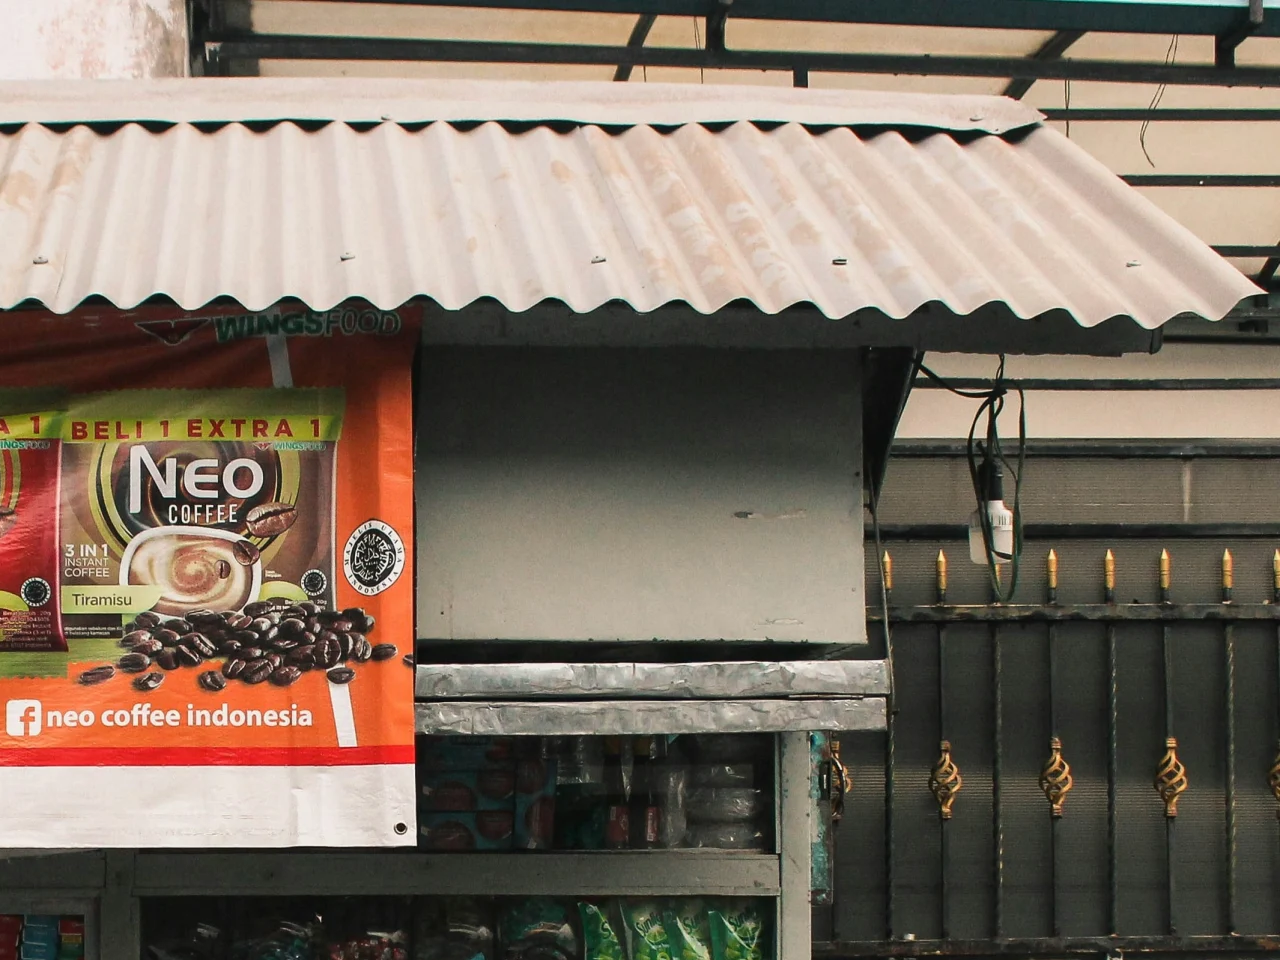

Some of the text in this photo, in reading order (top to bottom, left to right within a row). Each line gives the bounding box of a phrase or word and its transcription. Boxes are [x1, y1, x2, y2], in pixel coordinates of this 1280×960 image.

[30, 415, 41, 434] 1
[71, 419, 320, 440] BELI 1 EXTRA 1
[129, 445, 264, 514] NEO
[168, 504, 239, 524] COFFEE
[64, 544, 109, 558] 3 IN 1
[64, 558, 109, 567] INSTANT
[64, 567, 110, 578] COFFEE
[72, 593, 133, 608] Tiramisu
[47, 703, 313, 727] neo coffee indonesia
